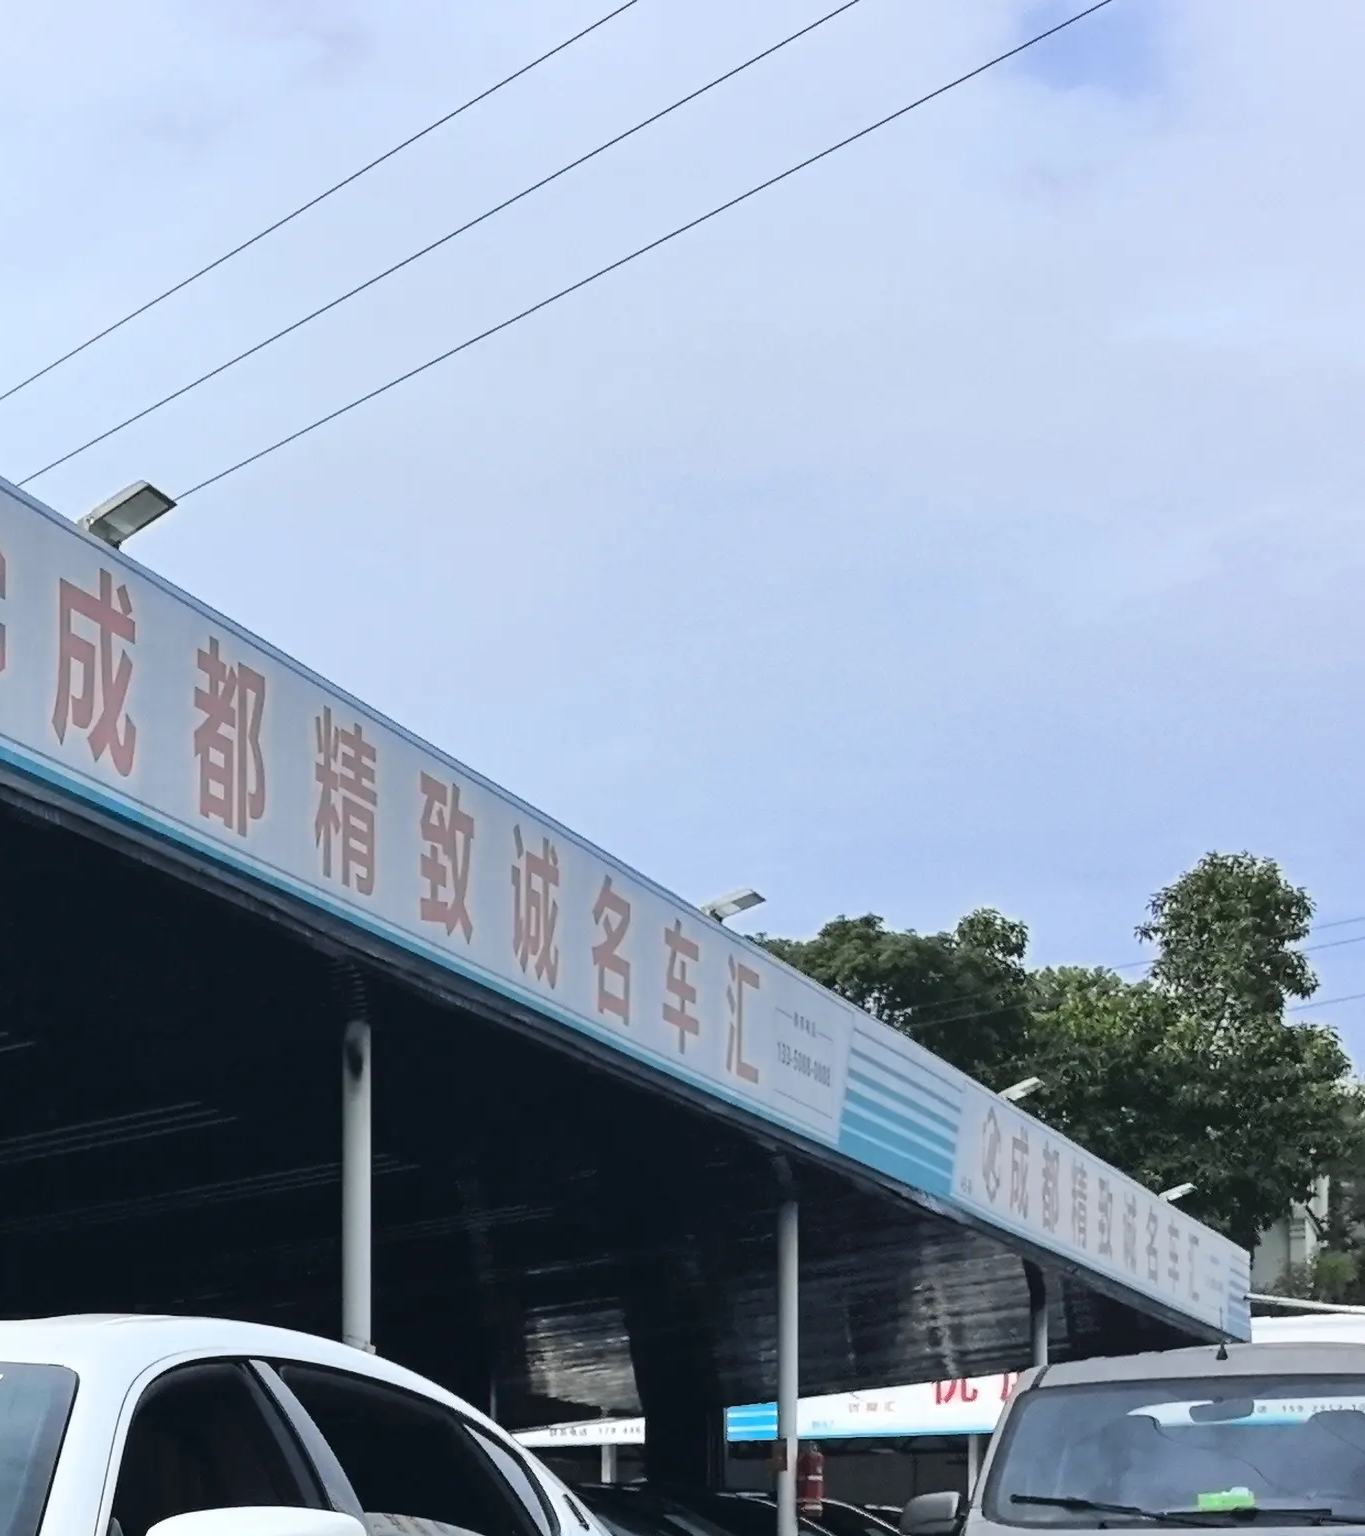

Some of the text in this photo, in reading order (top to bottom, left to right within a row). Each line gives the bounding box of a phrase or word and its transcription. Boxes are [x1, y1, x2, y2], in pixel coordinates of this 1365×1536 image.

[51, 567, 760, 1084] 成都精致诚名车汇
